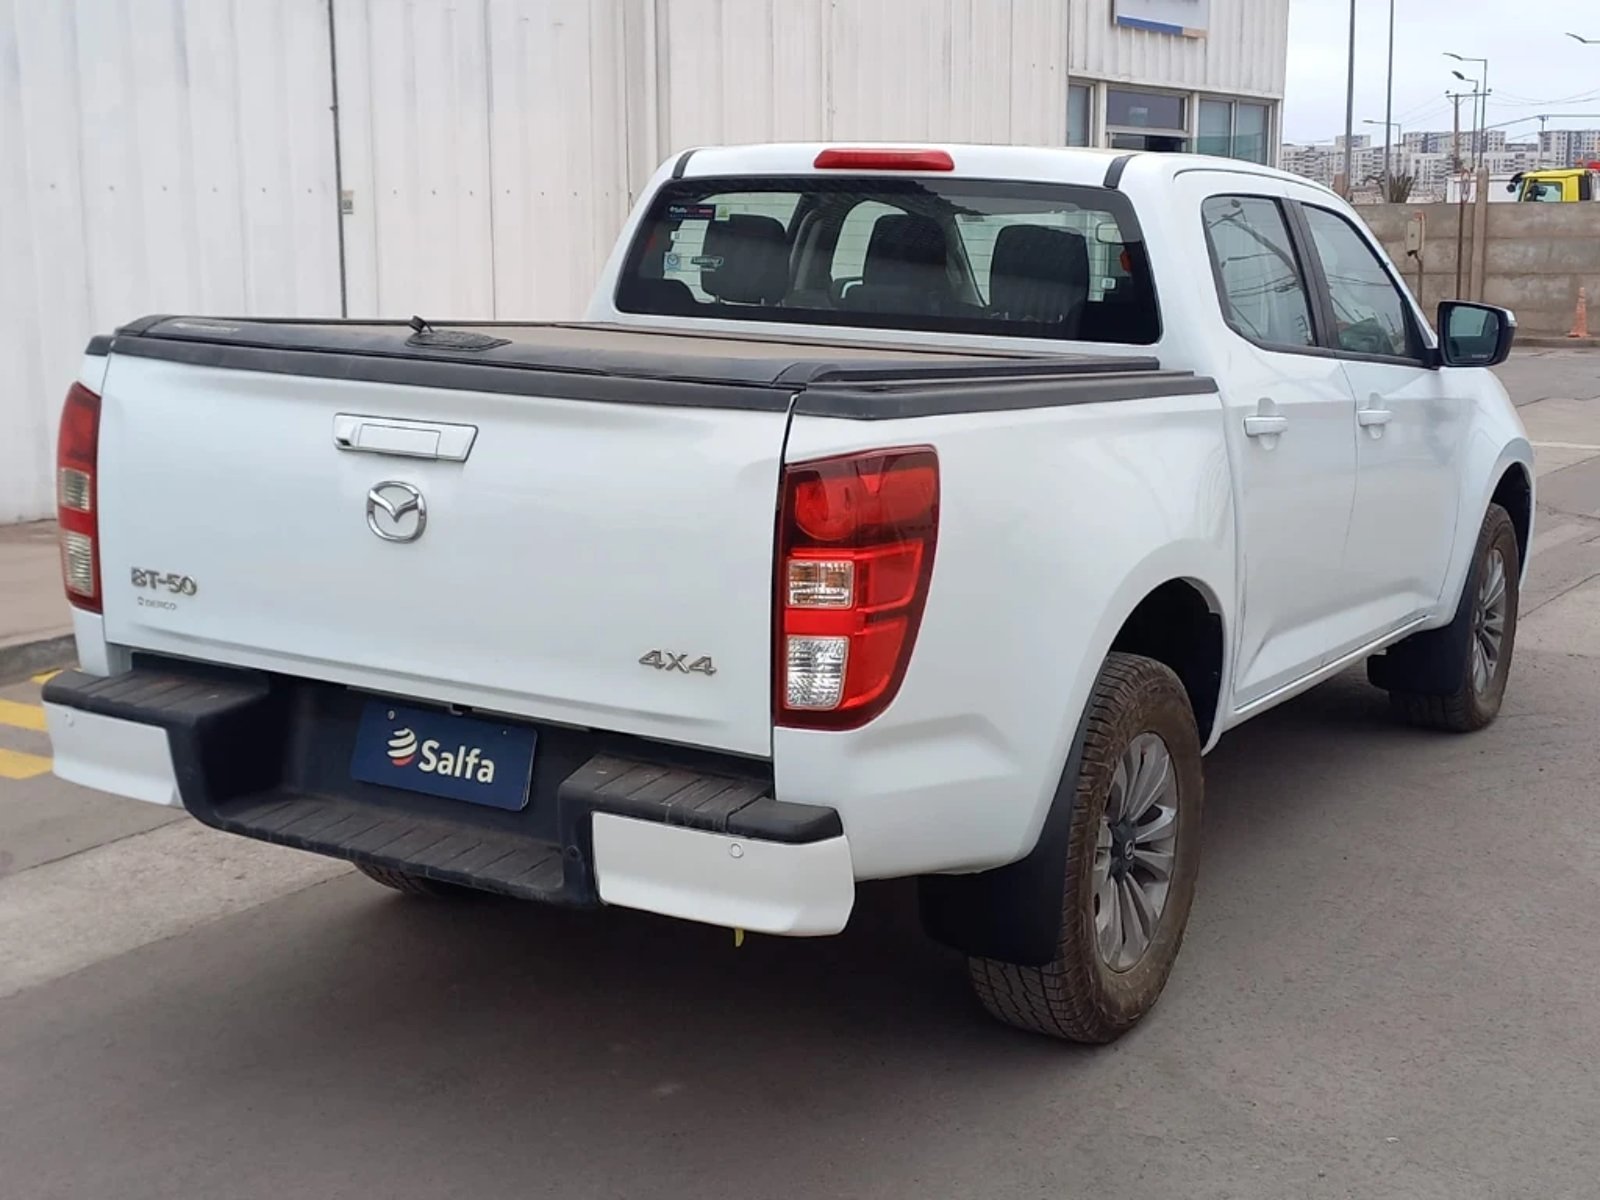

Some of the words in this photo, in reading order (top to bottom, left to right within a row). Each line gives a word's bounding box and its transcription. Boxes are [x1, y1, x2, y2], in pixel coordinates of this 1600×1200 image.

[130, 567, 198, 597] BT-50
[639, 650, 717, 676] 4X4
[418, 739, 496, 784] Salfa
